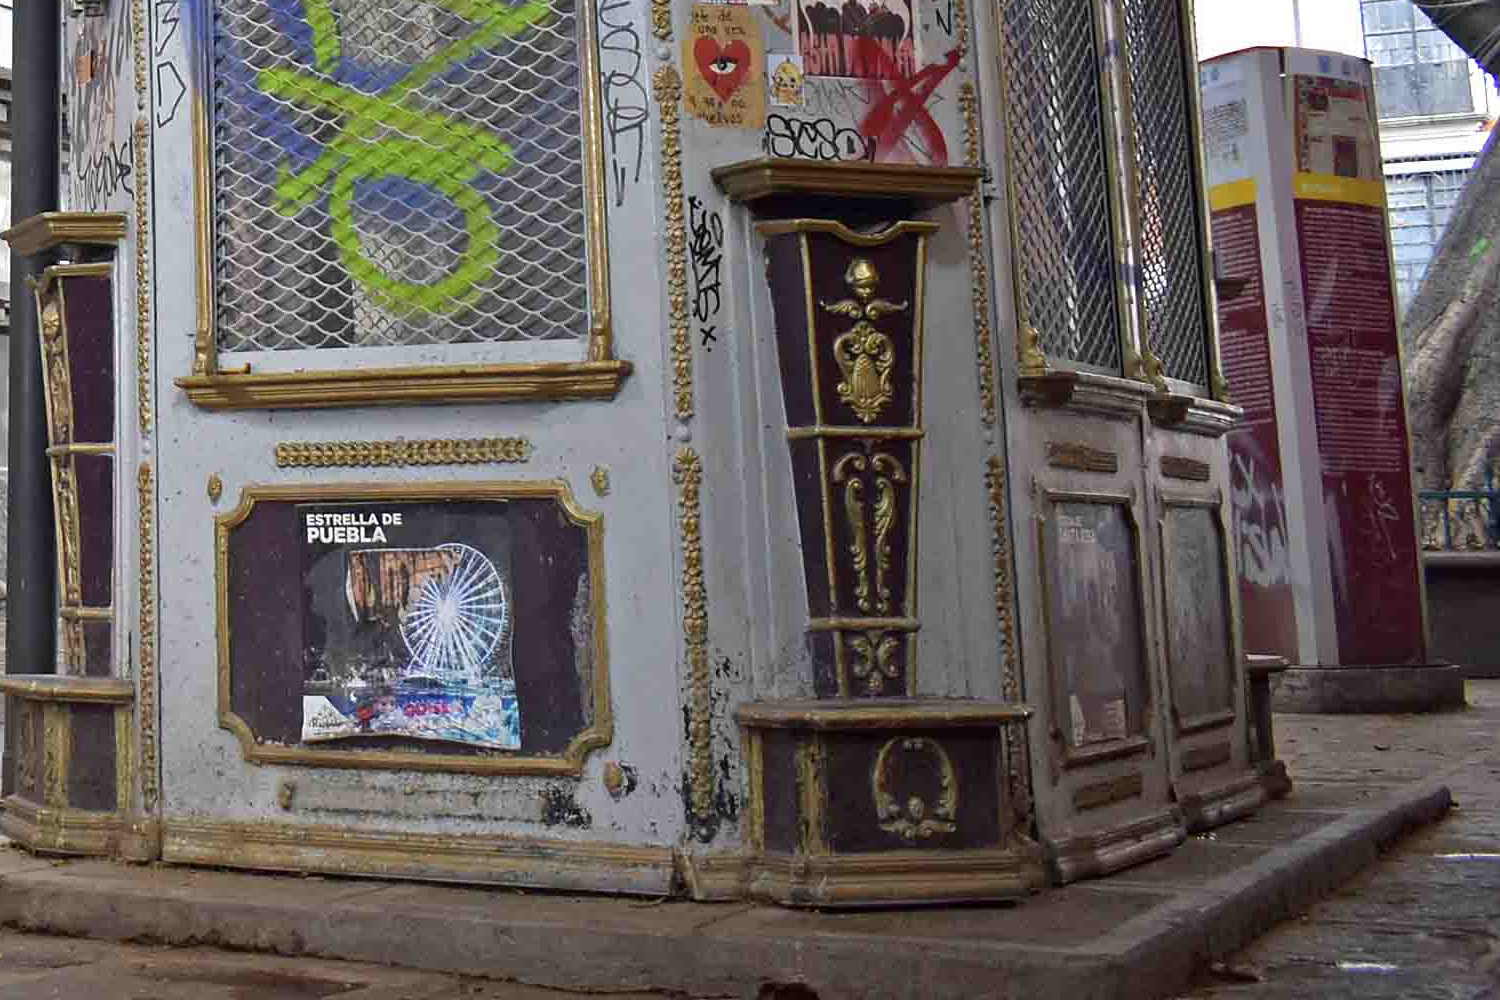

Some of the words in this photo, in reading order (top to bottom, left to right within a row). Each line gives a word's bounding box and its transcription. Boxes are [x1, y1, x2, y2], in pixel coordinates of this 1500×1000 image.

[306, 513, 379, 526] ESTRELLA
[382, 513, 403, 525] DE
[307, 526, 388, 544] PUEBLA
